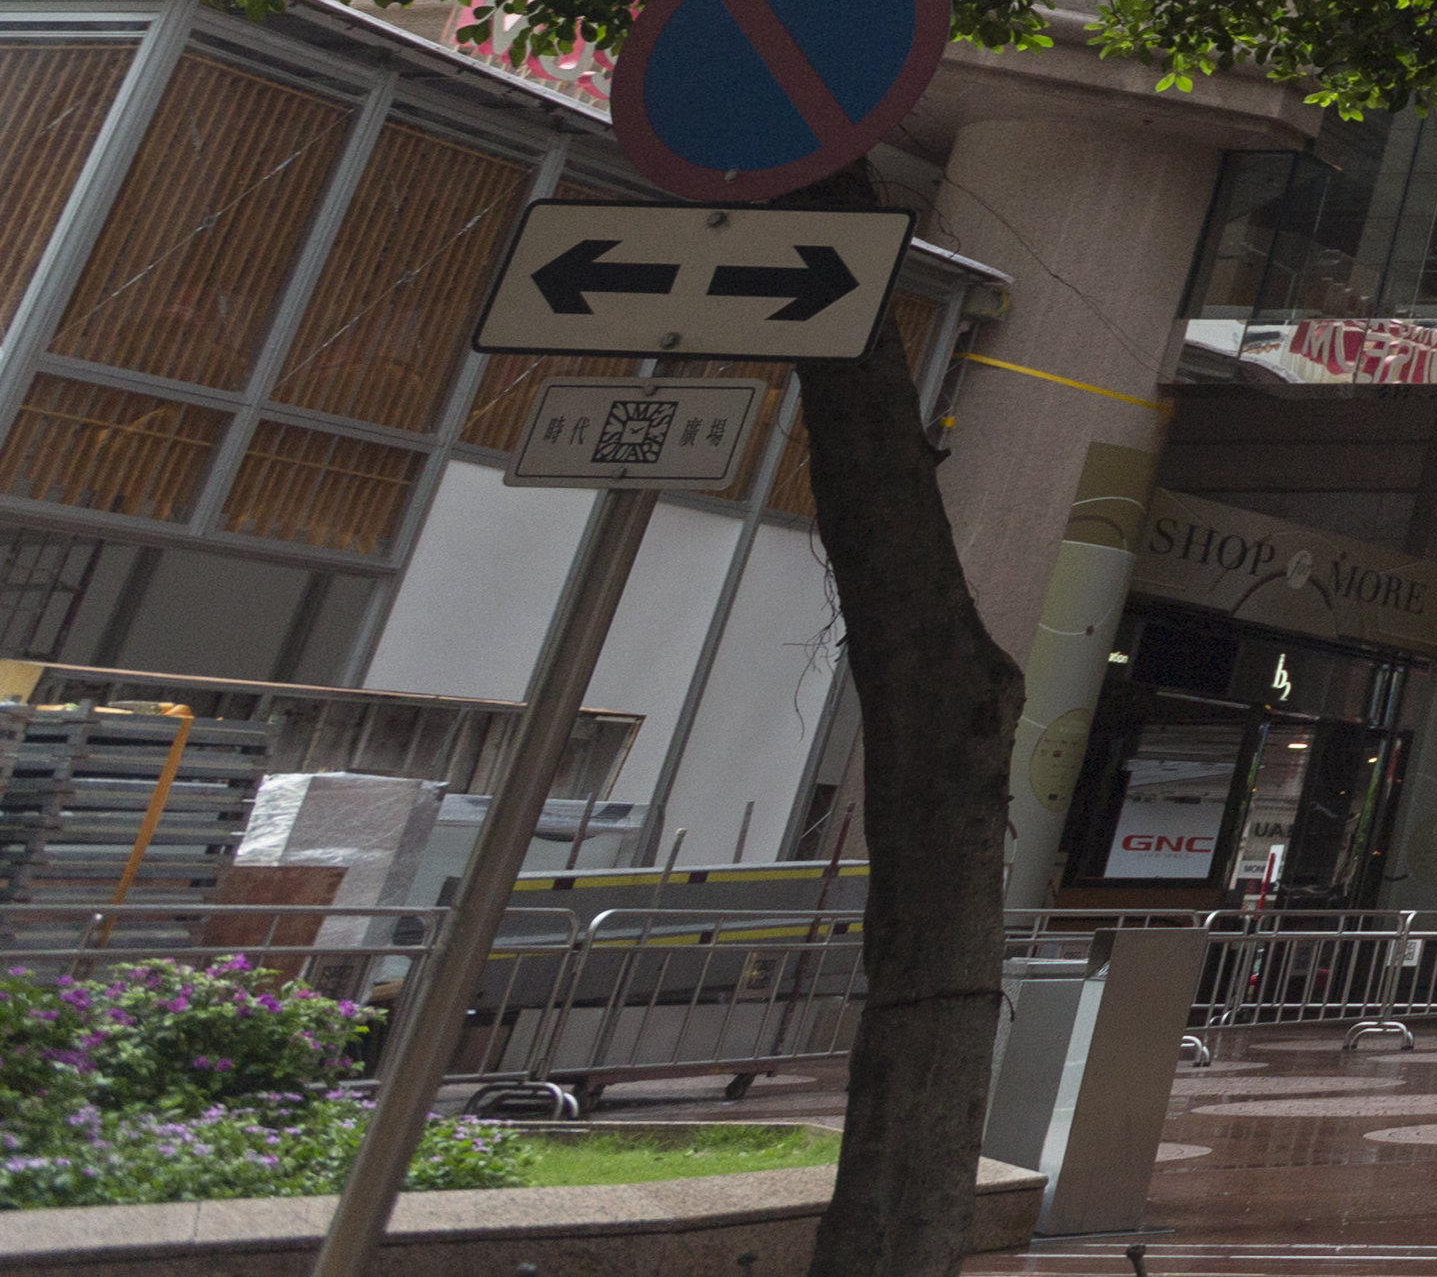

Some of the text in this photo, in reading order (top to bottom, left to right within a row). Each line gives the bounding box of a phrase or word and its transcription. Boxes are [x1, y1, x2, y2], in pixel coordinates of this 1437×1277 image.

[1149, 516, 1276, 576] SHOP
[1330, 558, 1429, 614] MORE
[1121, 833, 1215, 854] GNC
